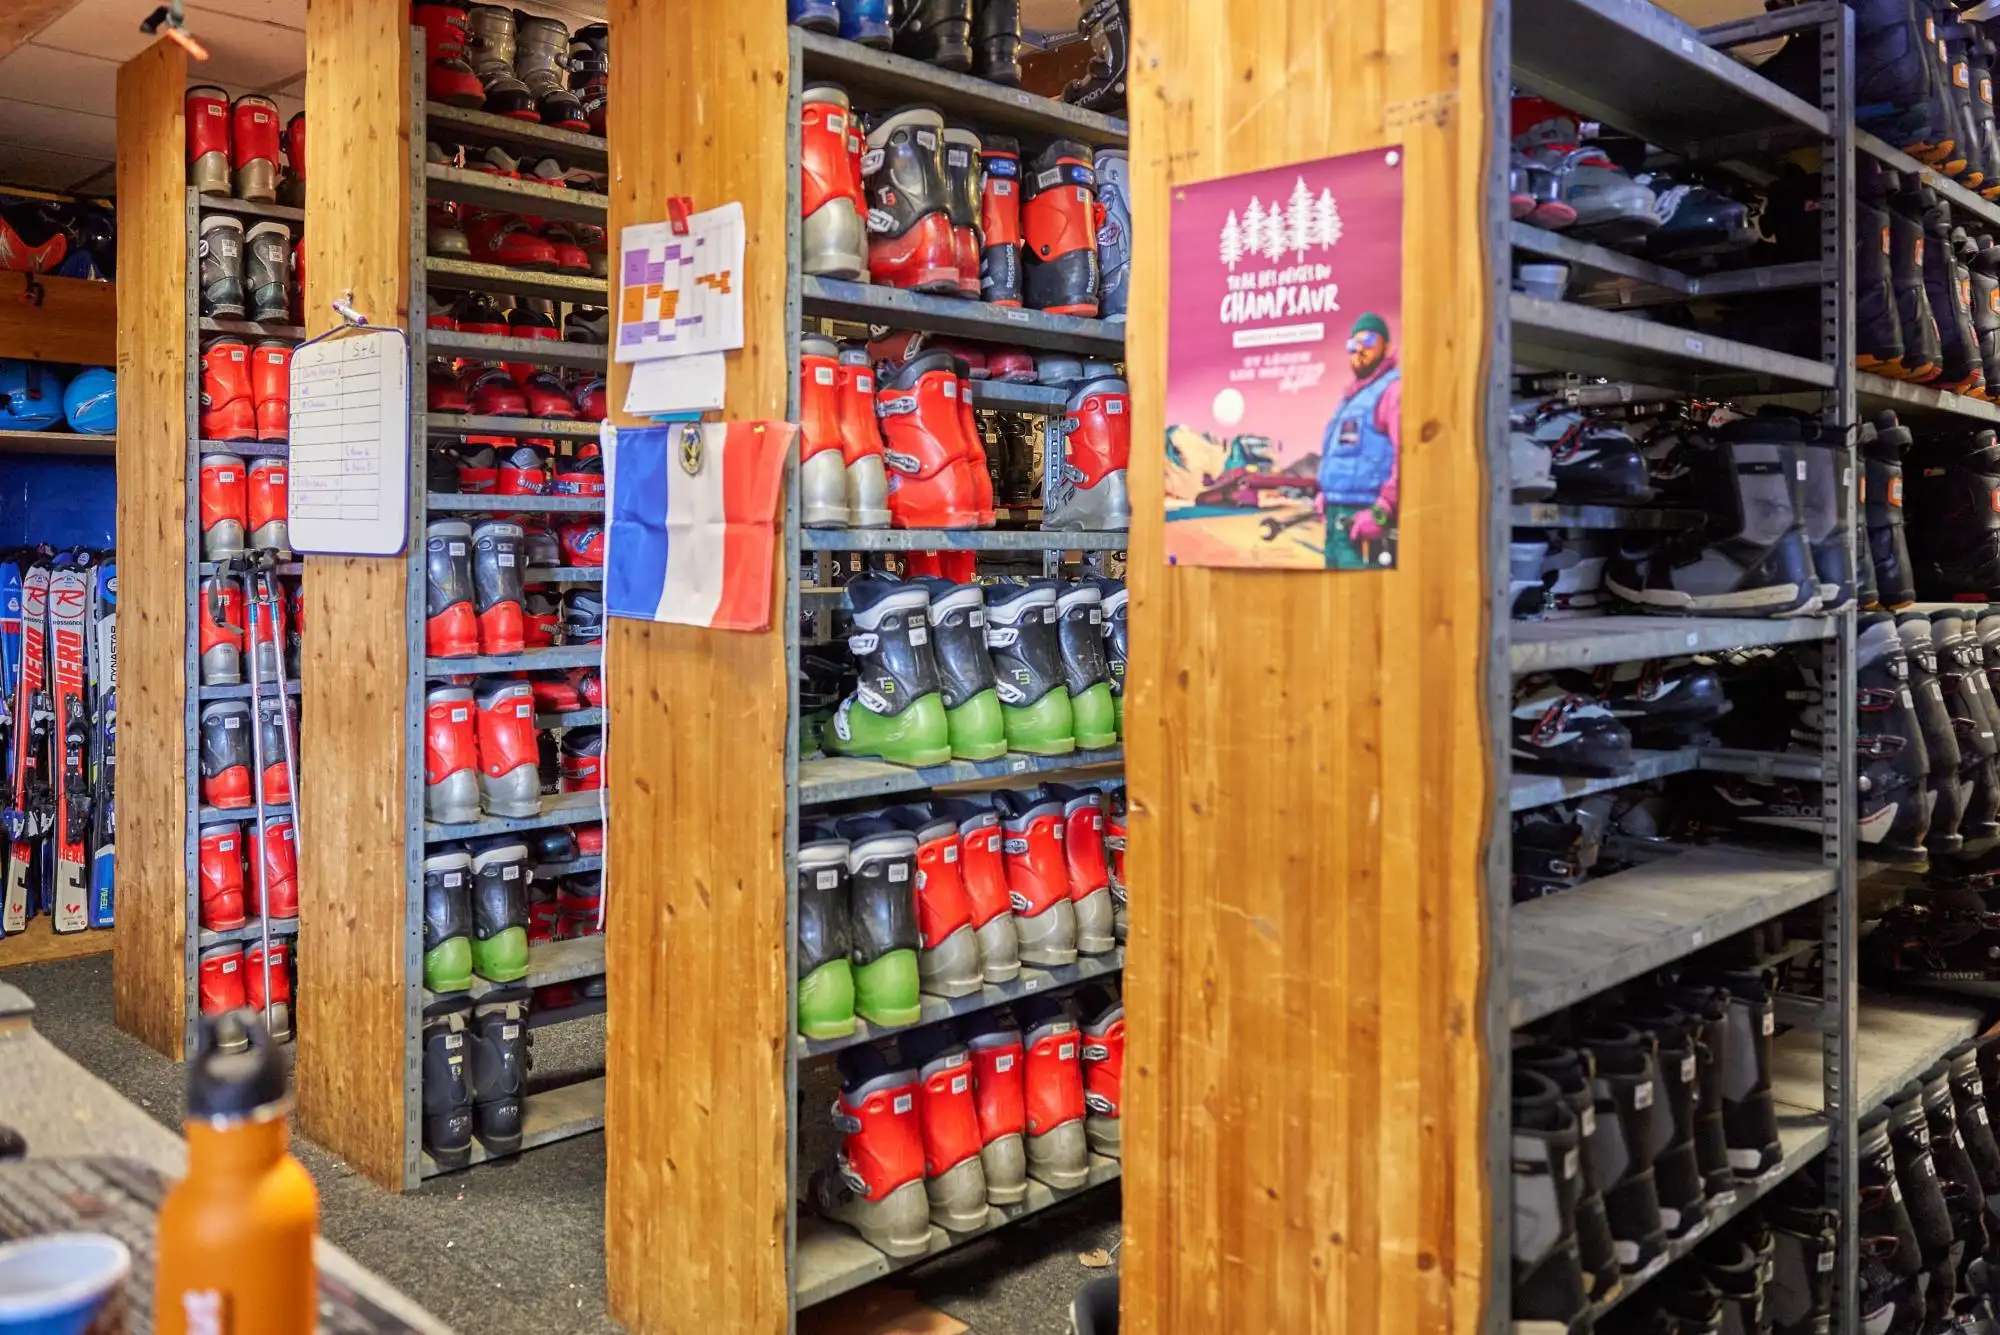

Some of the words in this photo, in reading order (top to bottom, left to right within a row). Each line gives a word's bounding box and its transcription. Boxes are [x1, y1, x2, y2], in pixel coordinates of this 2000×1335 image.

[1220, 283, 1340, 324] CHAMPSAUR
[56, 629, 82, 688] HERO
[1012, 668, 1030, 685] T3
[1109, 660, 1124, 676] T3
[877, 677, 894, 694] T3
